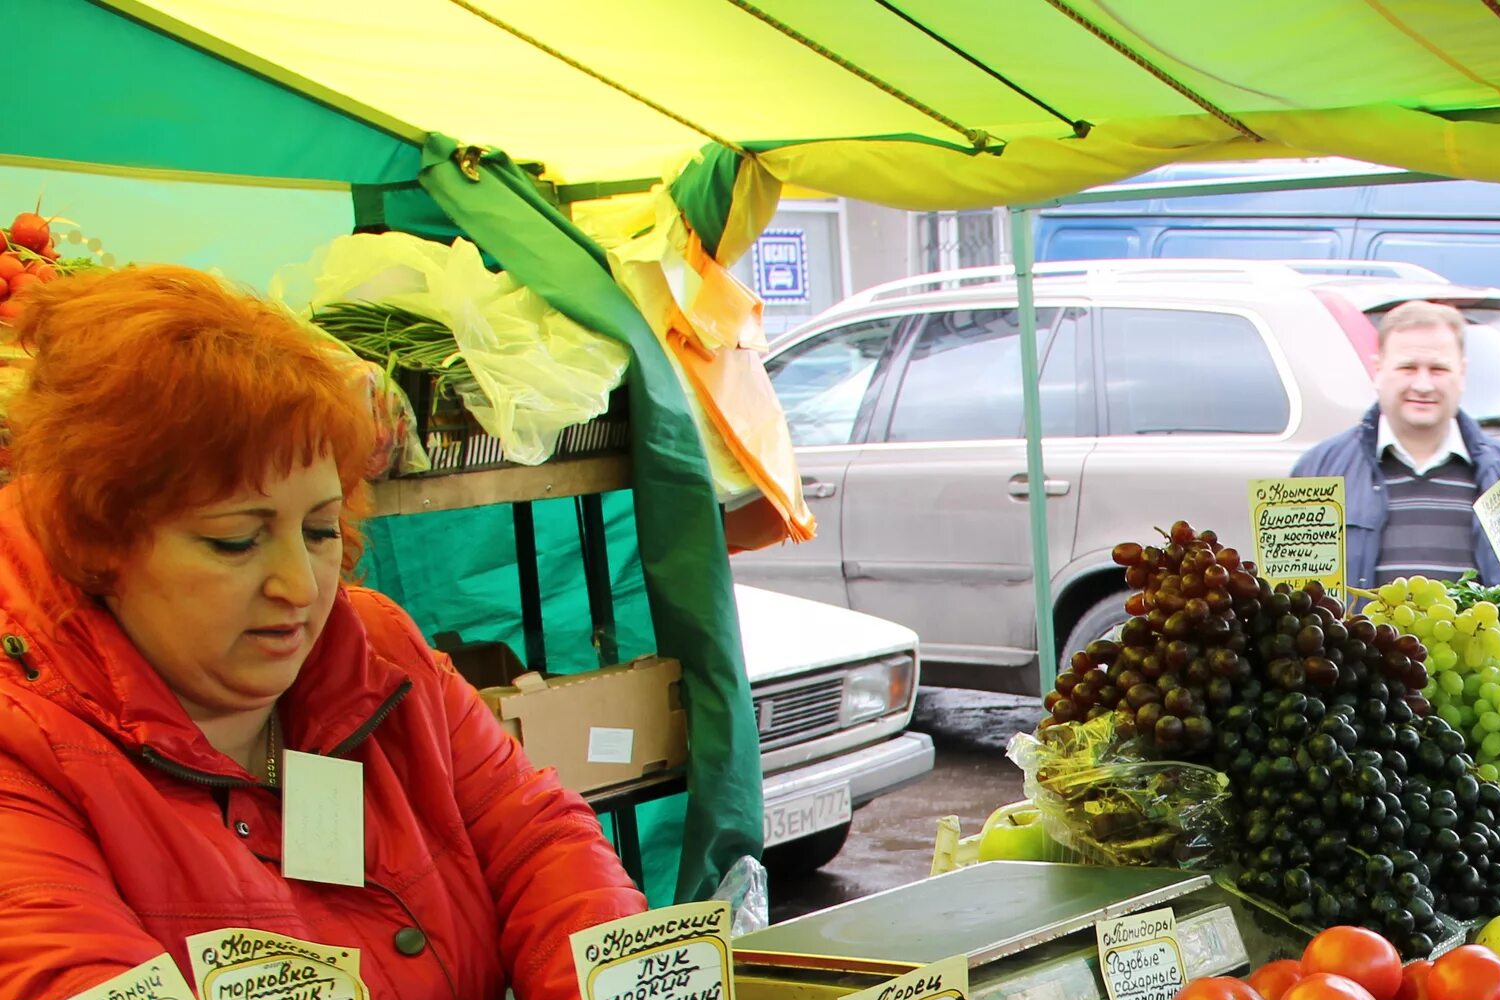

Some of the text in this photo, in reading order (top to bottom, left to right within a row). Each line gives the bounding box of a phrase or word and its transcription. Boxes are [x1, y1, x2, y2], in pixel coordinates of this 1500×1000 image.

[1269, 483, 1338, 504] Крымский
[1260, 532, 1276, 547] без
[1265, 559, 1336, 576] хрустящий
[602, 908, 725, 956] Крымский
[1110, 919, 1173, 942] Помидоры
[219, 963, 318, 1000] морковка
[1114, 966, 1177, 993] сахарные
